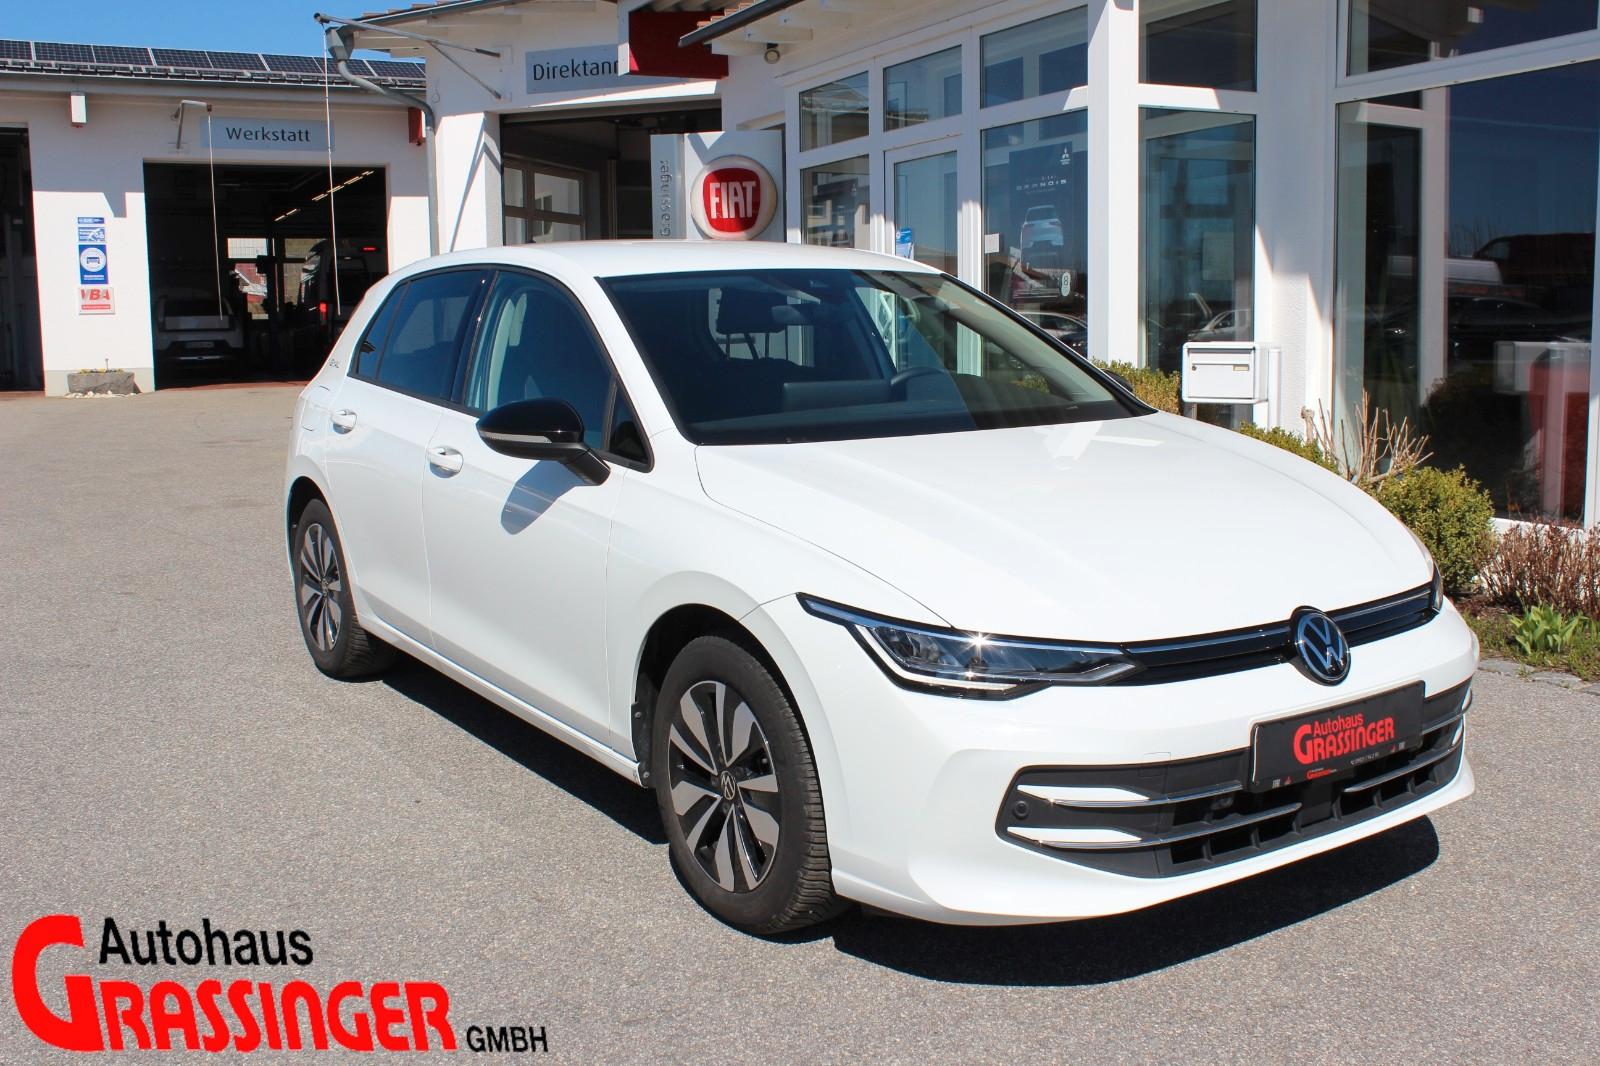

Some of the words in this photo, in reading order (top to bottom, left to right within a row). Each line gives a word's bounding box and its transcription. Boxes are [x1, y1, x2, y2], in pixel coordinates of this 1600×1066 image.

[226, 126, 310, 142] Werkstatt
[710, 181, 756, 219] FIAT
[1313, 713, 1364, 737] Autohaus
[1293, 717, 1395, 765] GRASSINGER
